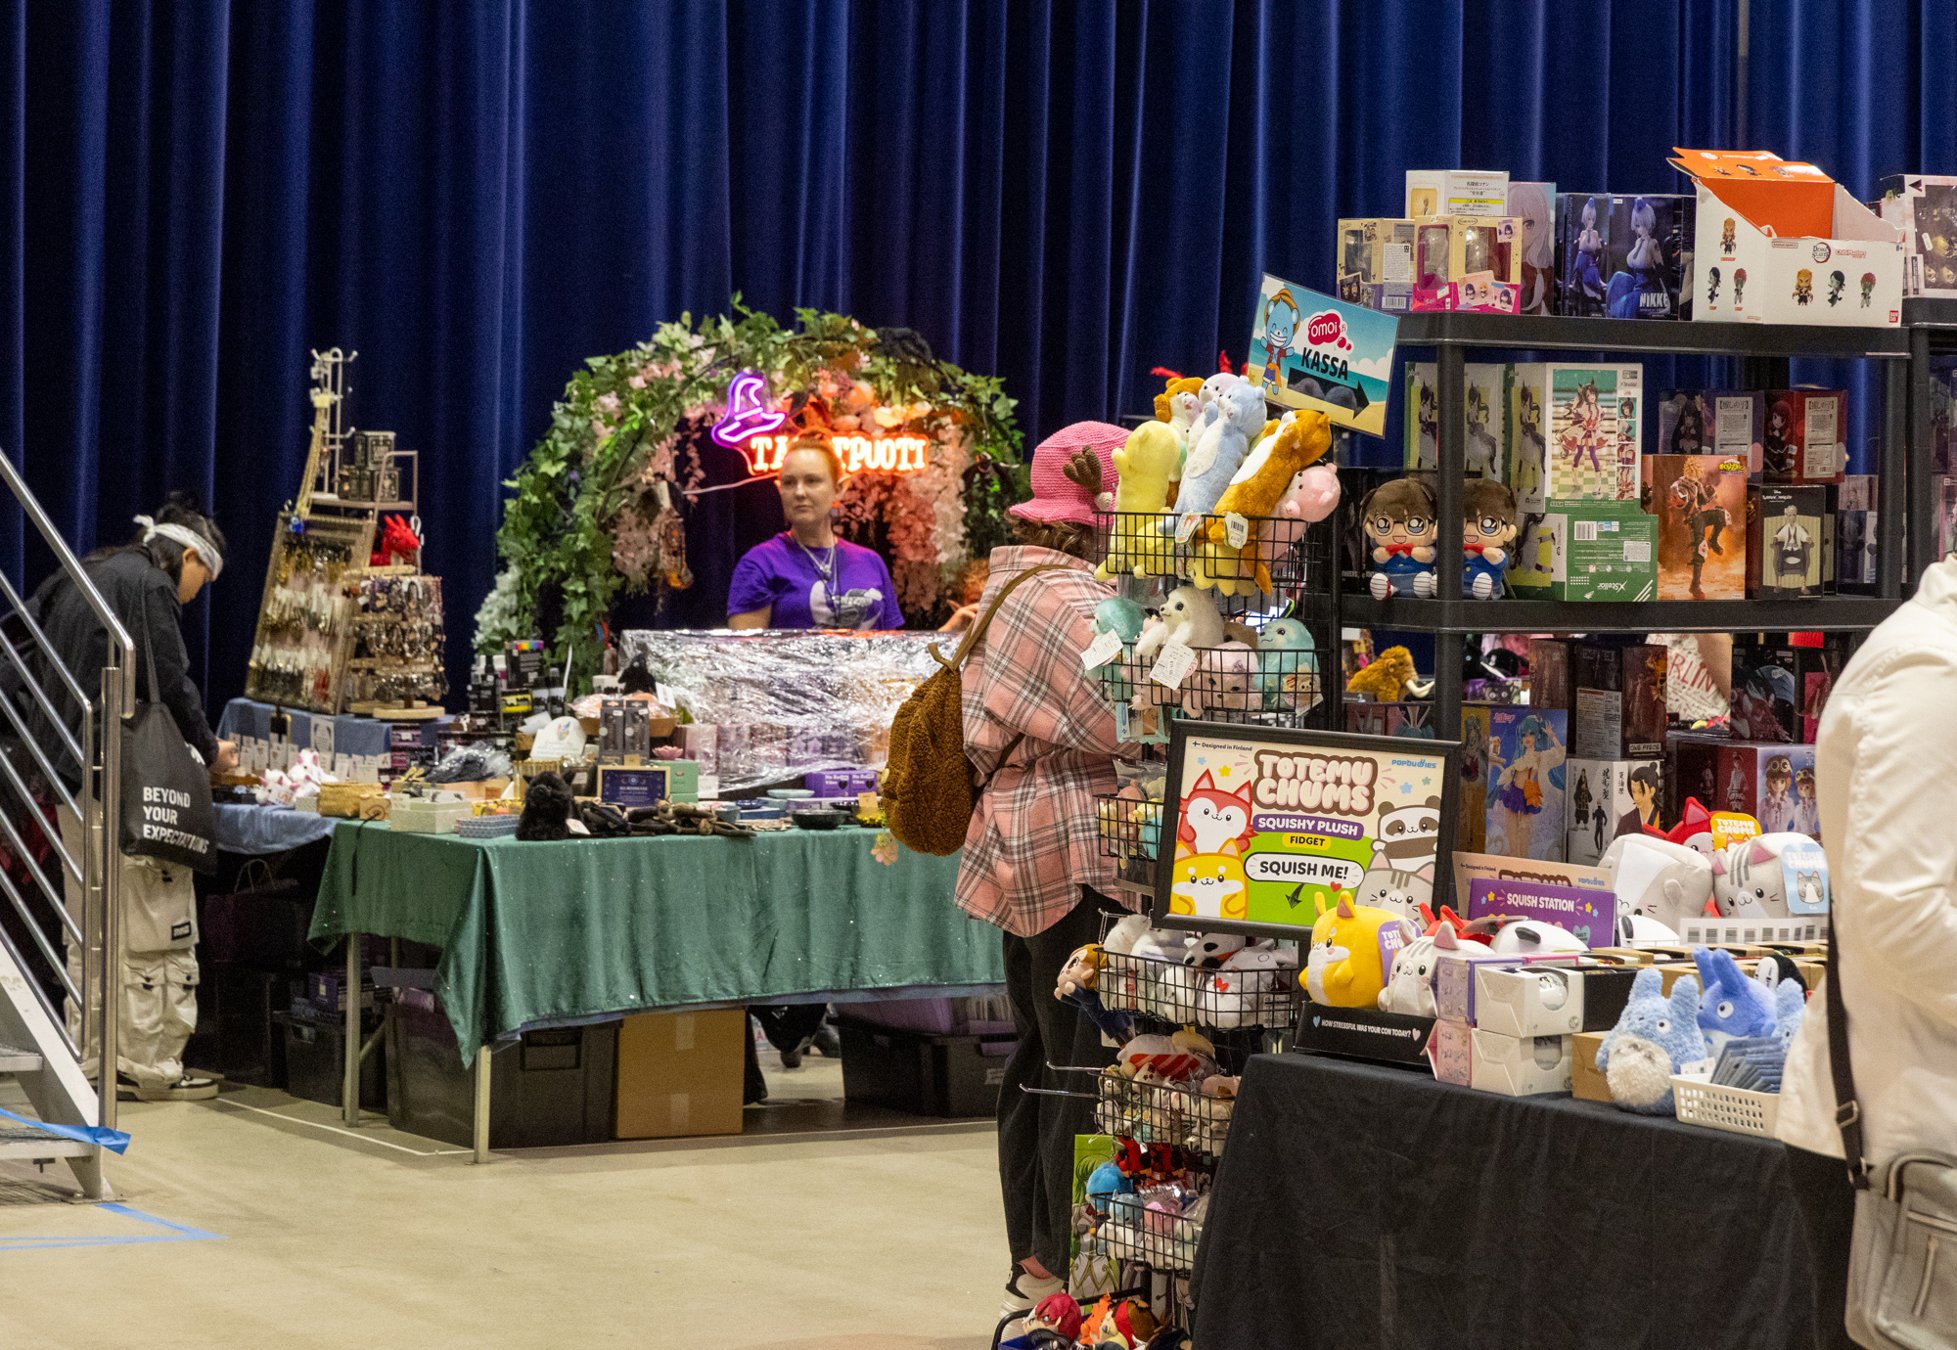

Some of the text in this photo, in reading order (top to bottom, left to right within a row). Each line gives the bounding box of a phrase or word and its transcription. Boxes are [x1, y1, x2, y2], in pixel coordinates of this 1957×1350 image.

[1311, 322, 1338, 338] omoi
[1301, 347, 1350, 381] KASSA
[750, 435, 927, 472] TATPUOTI
[1258, 753, 1374, 787] TOTEMU
[143, 787, 191, 808] BEYOND
[1256, 778, 1371, 812] CHUMS
[143, 806, 178, 825] YOUR
[1258, 817, 1359, 837] SQUISHY PLUSH
[1289, 836, 1325, 847] FIDGET
[1260, 860, 1349, 880] SQUISH ME!
[1507, 893, 1575, 912] SQUISH STATION
[1321, 1019, 1412, 1038] HOW STRESSFUL WAS YOUR CON TODAY?
